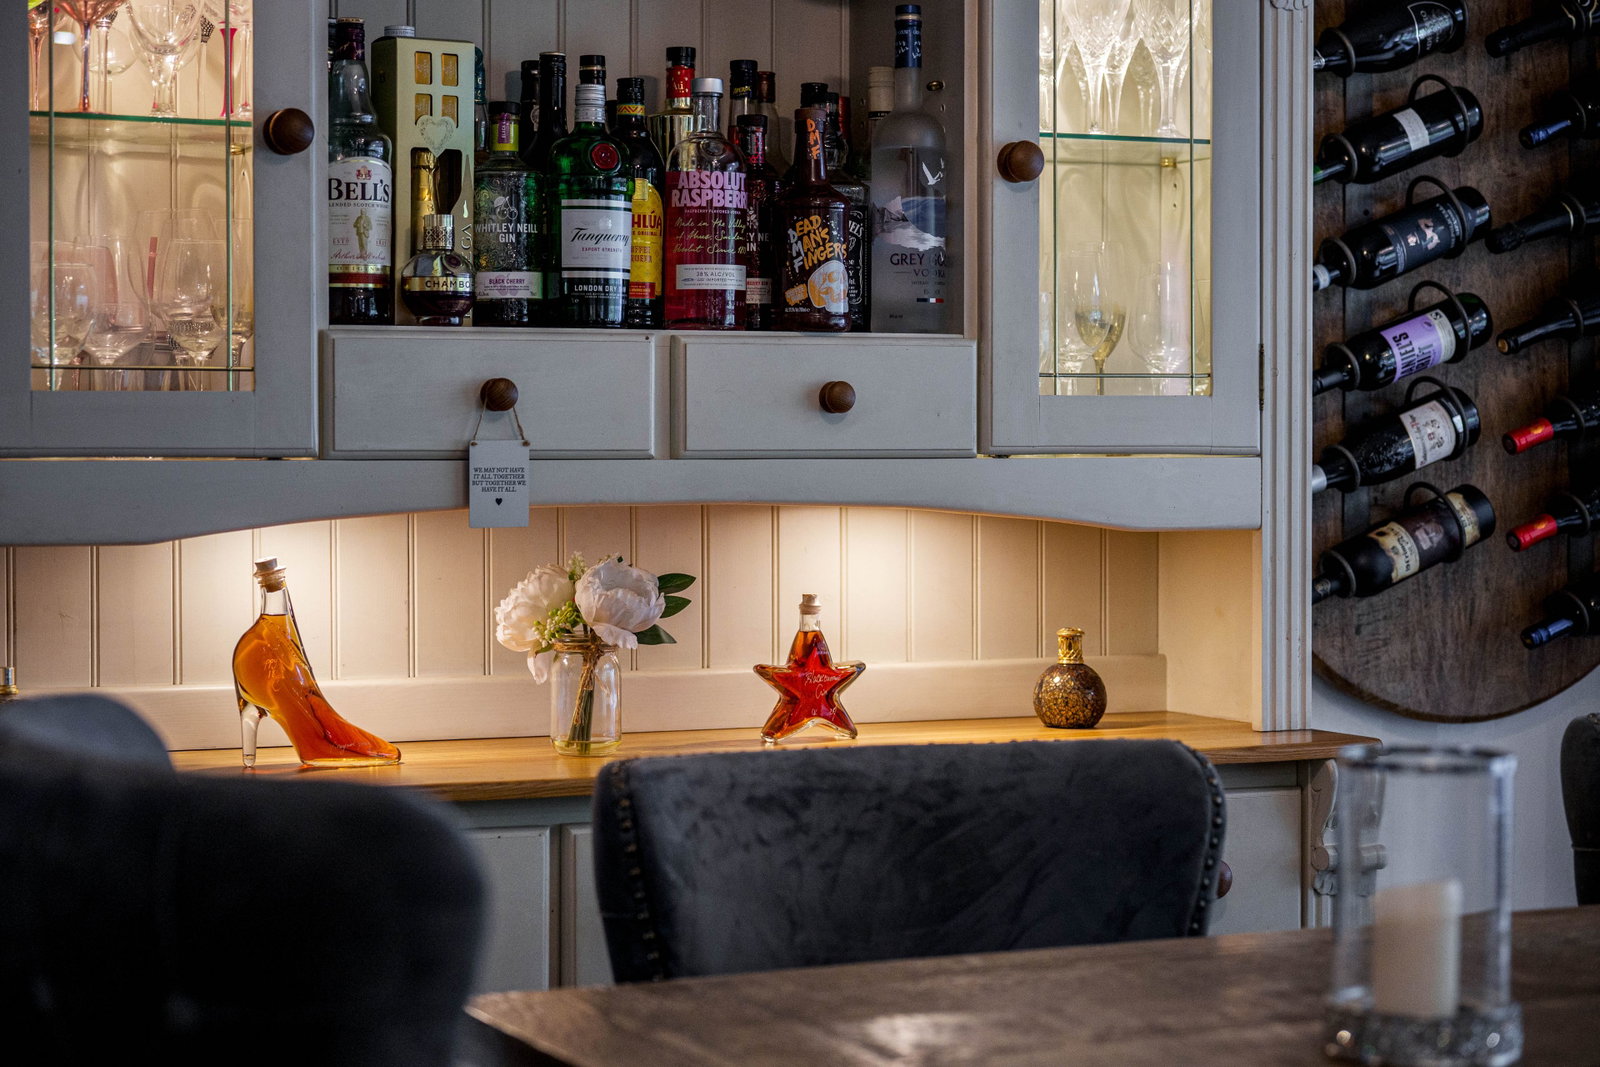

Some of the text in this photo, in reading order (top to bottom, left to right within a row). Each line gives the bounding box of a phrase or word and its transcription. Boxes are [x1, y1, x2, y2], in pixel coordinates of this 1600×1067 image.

[678, 170, 747, 191] ABSOLUT
[328, 178, 390, 203] BELL'S
[671, 189, 748, 209] RASPBERR
[475, 223, 538, 233] WHITLEY NEILL
[632, 210, 662, 231] HLÚA
[787, 215, 822, 243] DEAD
[499, 234, 516, 243] GIN
[746, 242, 757, 252] IN
[793, 242, 848, 273] FINGERS
[890, 252, 925, 266] GREY
[425, 280, 471, 289] CHAMBO
[574, 284, 603, 292] LONDON
